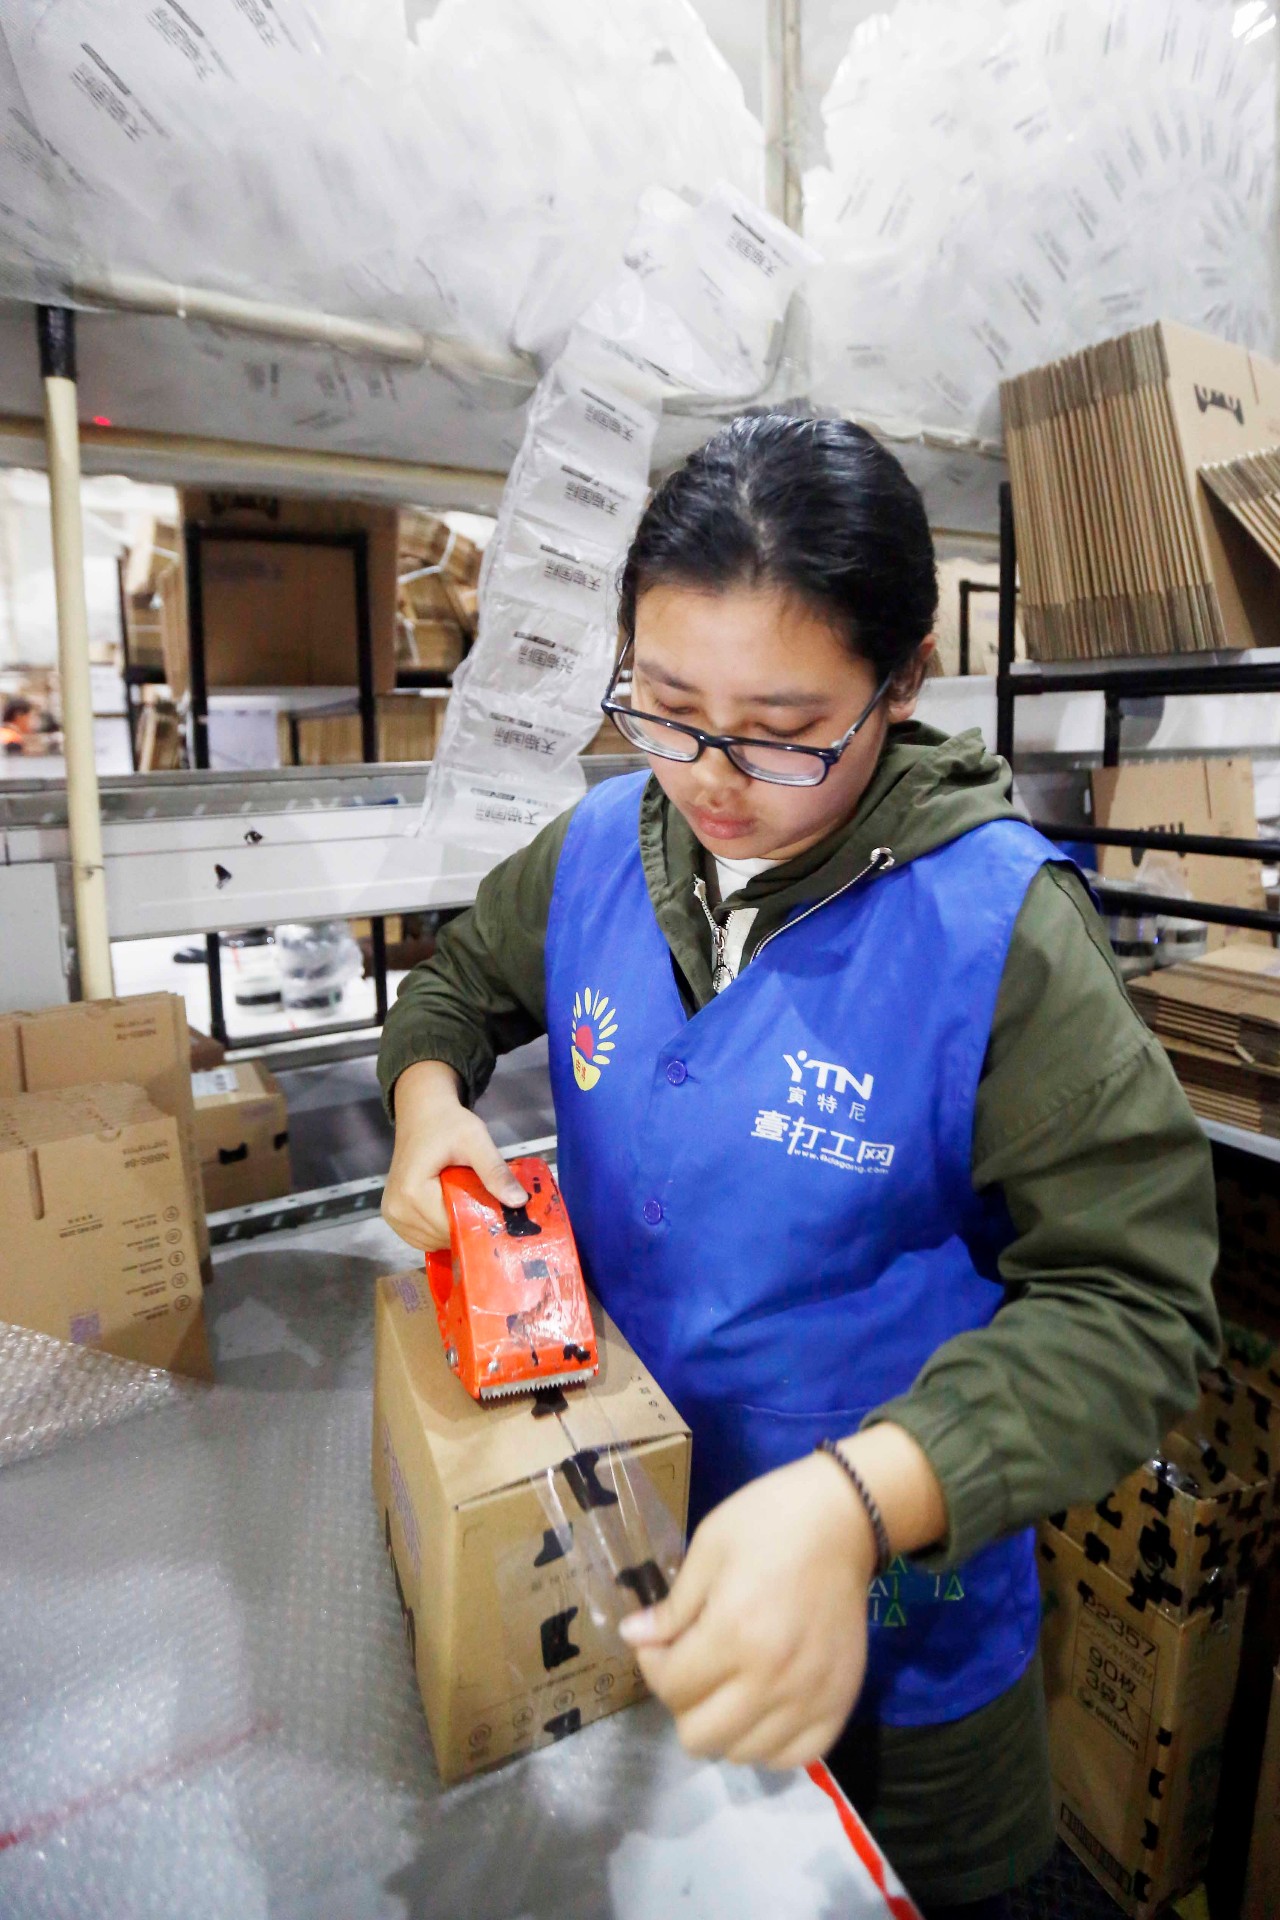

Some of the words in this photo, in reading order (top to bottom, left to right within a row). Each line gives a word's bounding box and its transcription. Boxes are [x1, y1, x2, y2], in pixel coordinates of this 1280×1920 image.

[494, 726, 557, 755] 天猫国际
[782, 1050, 874, 1100] YTN
[786, 1086, 866, 1123] 寅特尼
[751, 1109, 895, 1167] 壹打工网
